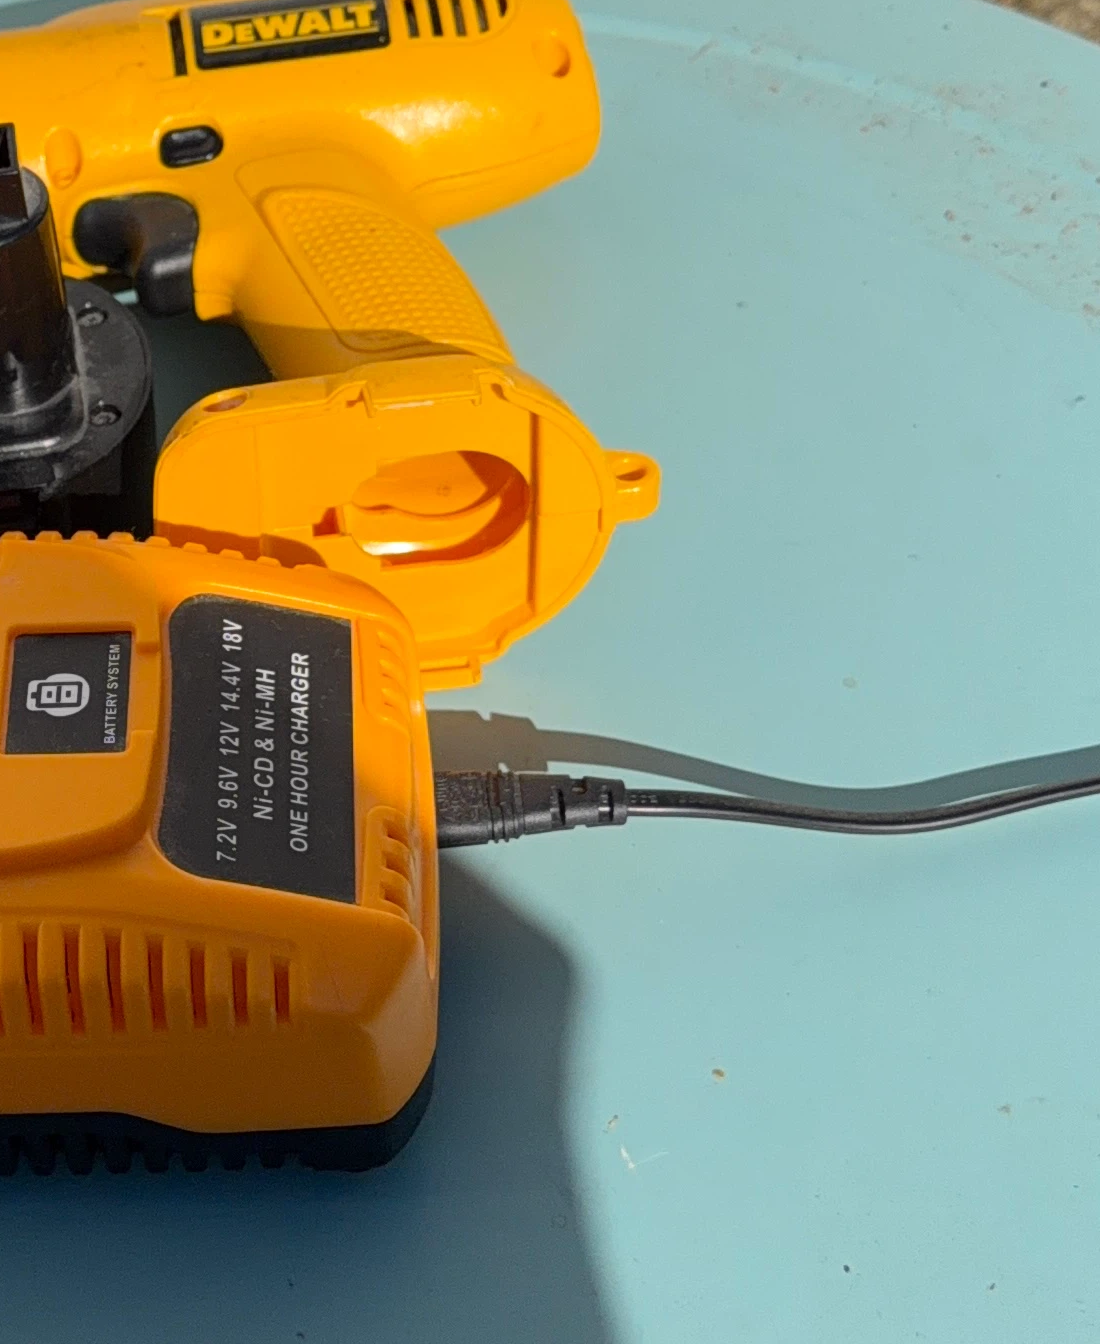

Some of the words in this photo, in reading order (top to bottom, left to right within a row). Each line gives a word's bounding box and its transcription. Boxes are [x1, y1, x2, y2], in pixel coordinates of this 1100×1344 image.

[221, 618, 243, 652] 18V
[106, 644, 121, 690] SYSTEM
[220, 661, 242, 711] 14.4V
[103, 692, 118, 744] BATTERY
[254, 668, 276, 732] Ni-MH
[290, 652, 310, 745] CHARGER
[219, 721, 240, 756] 12V
[254, 738, 275, 752] &
[217, 765, 239, 809] 9.6V
[252, 757, 274, 820] Ni-CD
[289, 749, 309, 806] HOUR
[216, 818, 237, 862] 7.2V
[289, 809, 308, 852] ONE
